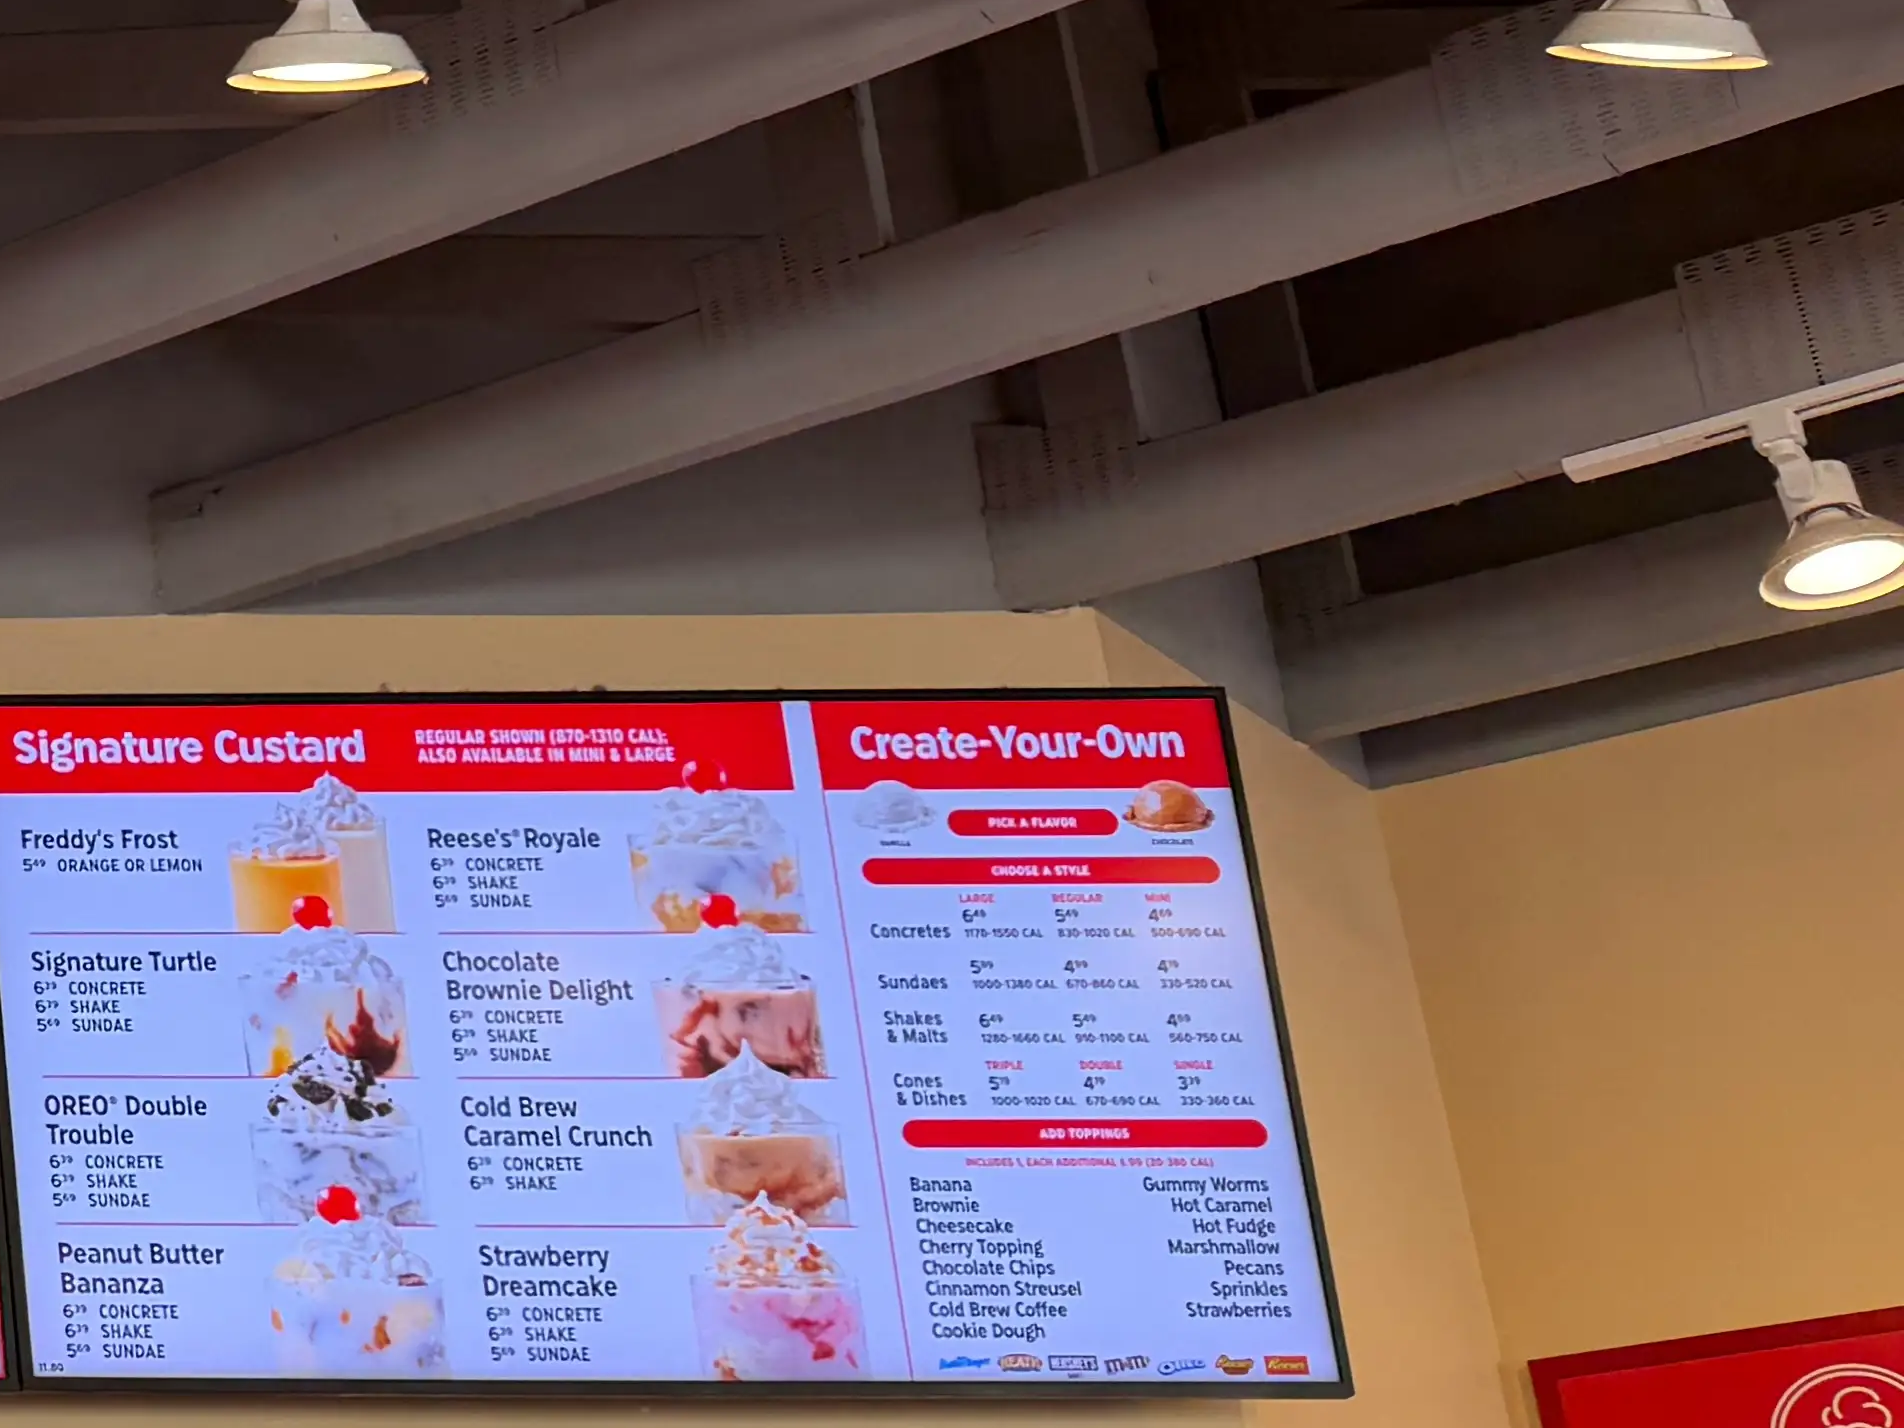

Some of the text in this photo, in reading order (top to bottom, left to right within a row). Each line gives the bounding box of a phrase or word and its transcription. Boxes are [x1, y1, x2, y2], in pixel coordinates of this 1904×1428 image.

[13, 730, 365, 773] Signature Custard
[851, 724, 1184, 759] Create-Your-Own
[21, 829, 178, 854] Freddy's Frost
[32, 951, 216, 977] Signature Turtle
[913, 1198, 979, 1212] Brownie
[479, 1245, 609, 1273] Strawberry
[483, 1275, 617, 1296] Dreamcake
[1186, 1301, 1292, 1317] Strawberries
[932, 1322, 1045, 1343] Cookie Dough
